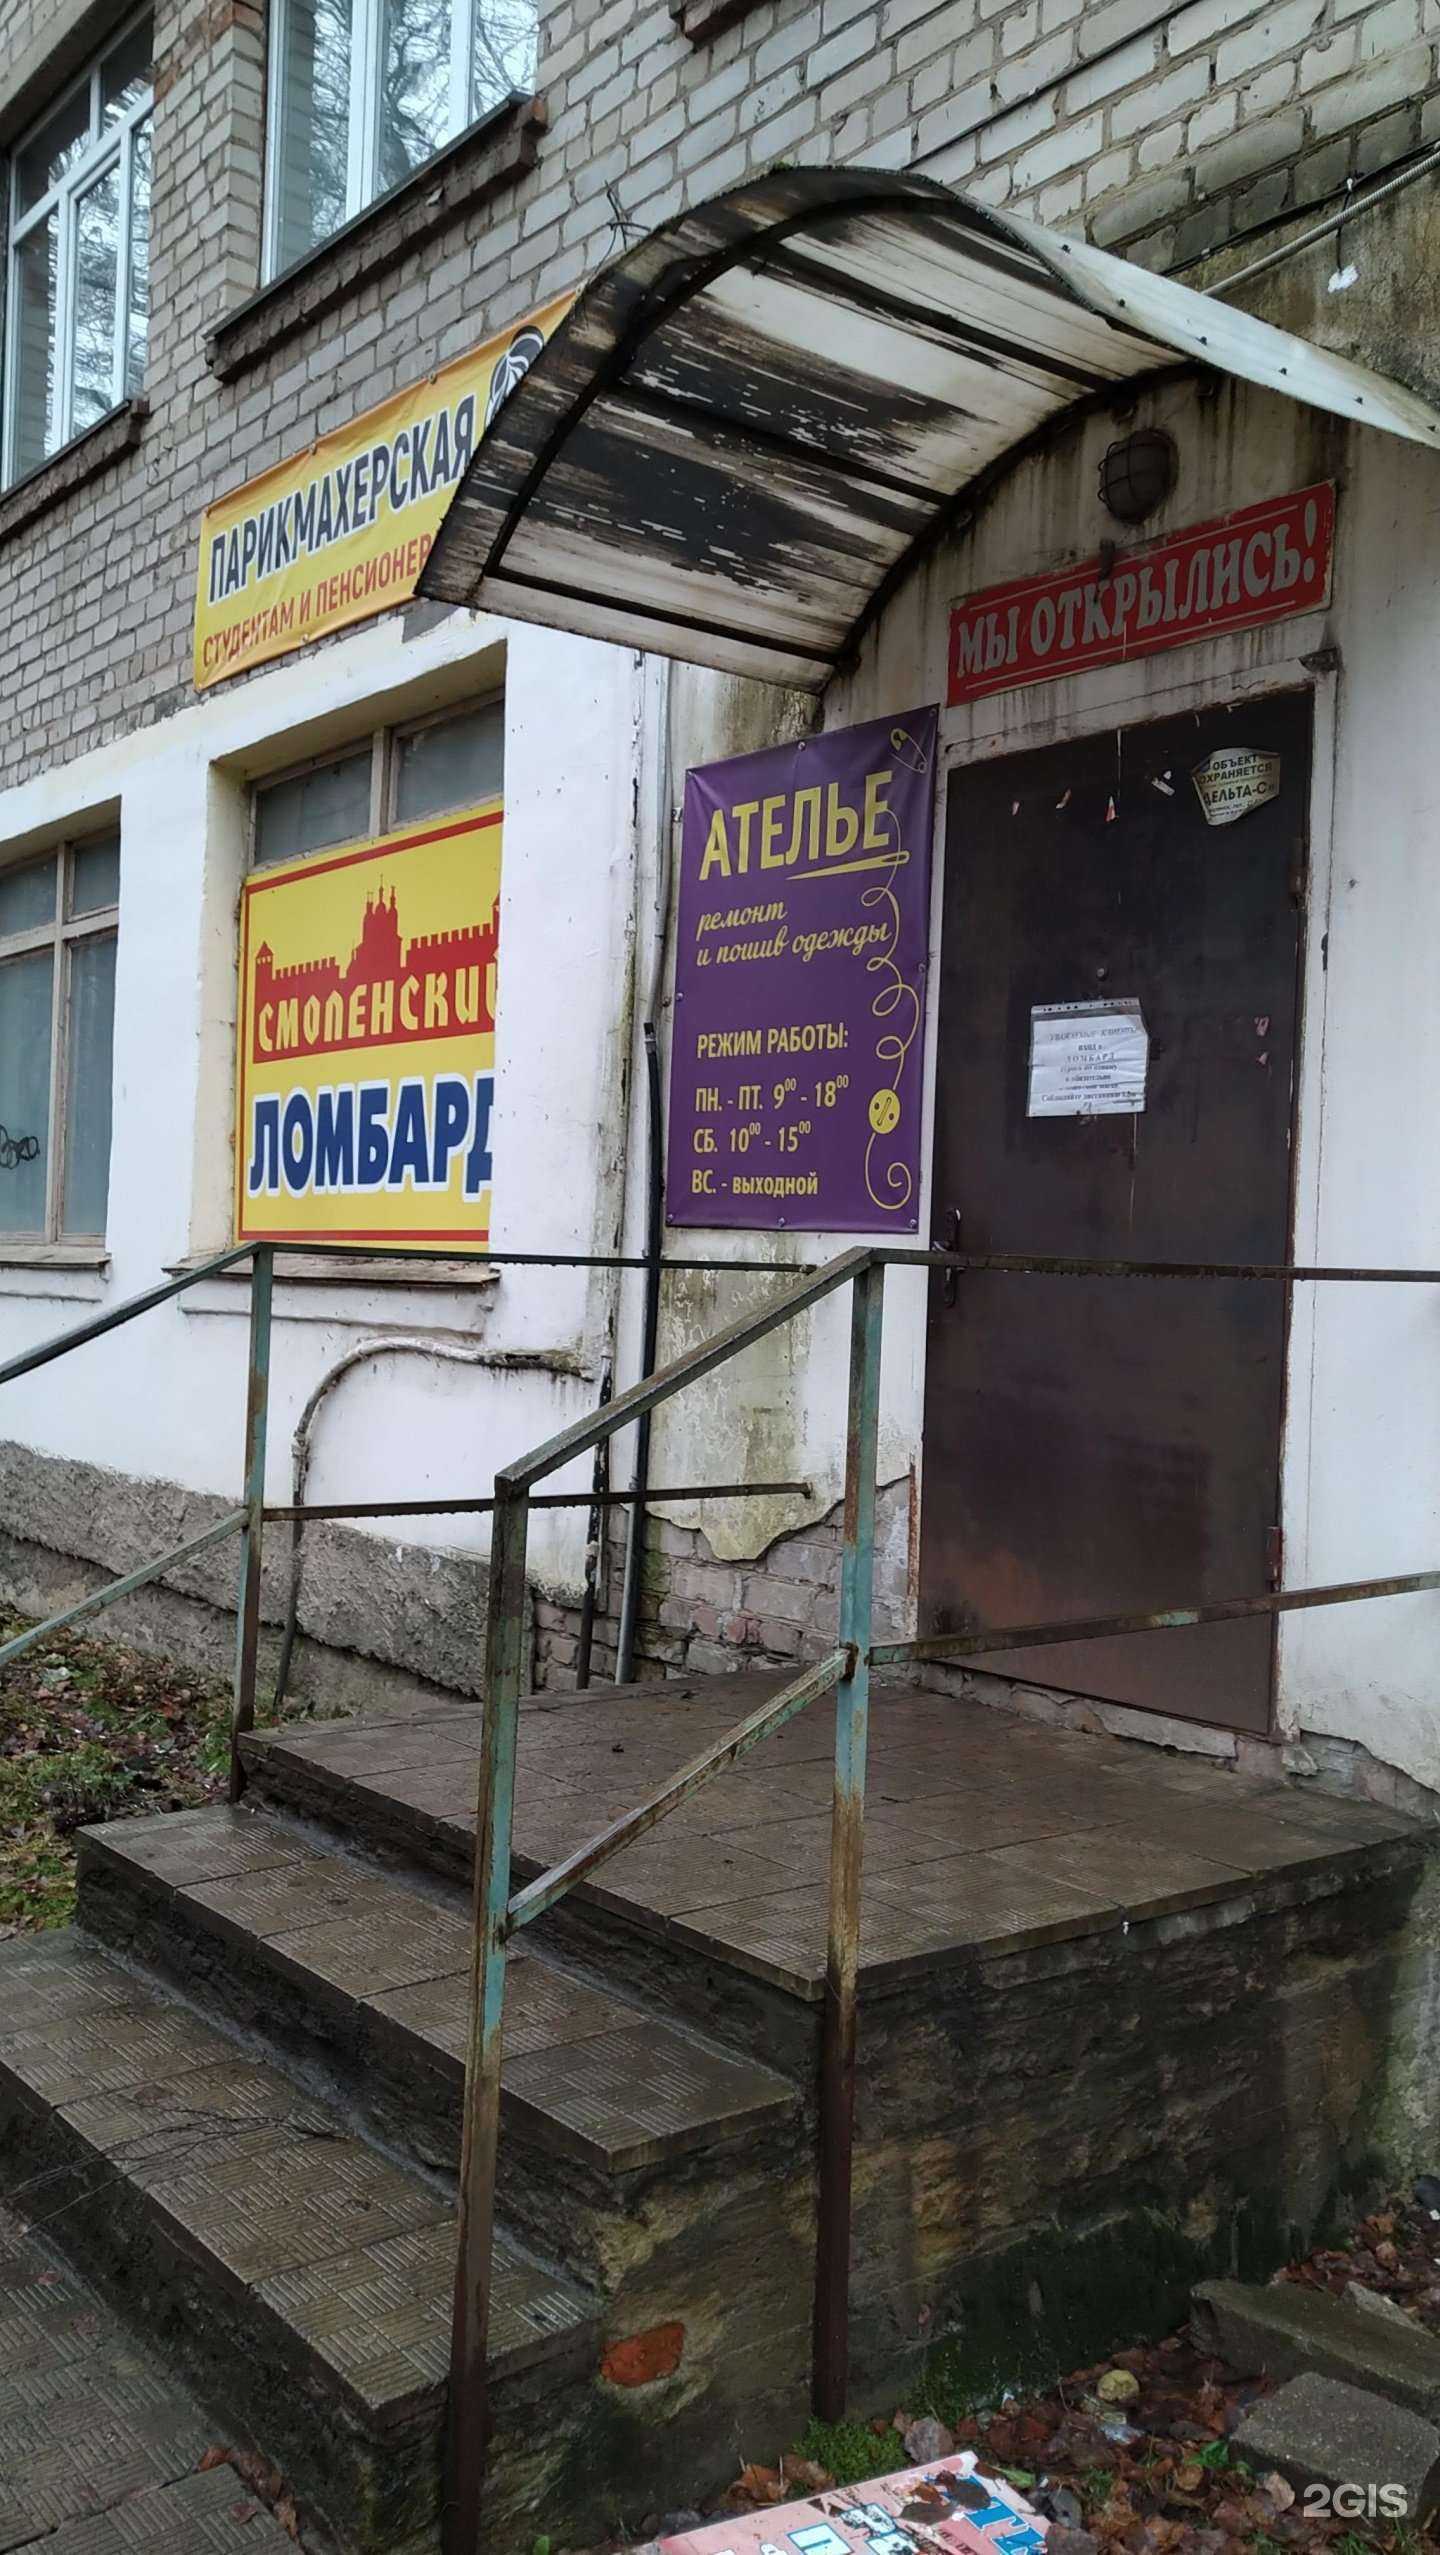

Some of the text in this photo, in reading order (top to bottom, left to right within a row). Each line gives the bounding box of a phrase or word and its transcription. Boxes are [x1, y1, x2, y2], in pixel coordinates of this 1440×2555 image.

[208, 394, 476, 603] ПАРИКМАХЕРСКАЯ
[956, 498, 1319, 679] МЫ ОТКРЫЛИСЬ!
[202, 600, 294, 668] СТУДЕНТАМ
[299, 588, 312, 626] И
[1200, 761, 1273, 785] ОХРАНЯЕТСЯ
[1212, 754, 1258, 771] ОБЪЕКТ
[698, 770, 893, 881] АТЕЛЬЕ
[696, 900, 788, 942] ремонт
[696, 921, 893, 967] и пошив одежды
[696, 1022, 849, 1059] РЕЖИМ РАБОТЫ:
[695, 1087, 722, 1113] ПН.
[738, 1084, 763, 1111] ПТ.
[693, 1128, 718, 1154] СБ.
[691, 1169, 716, 1194] ВС.
